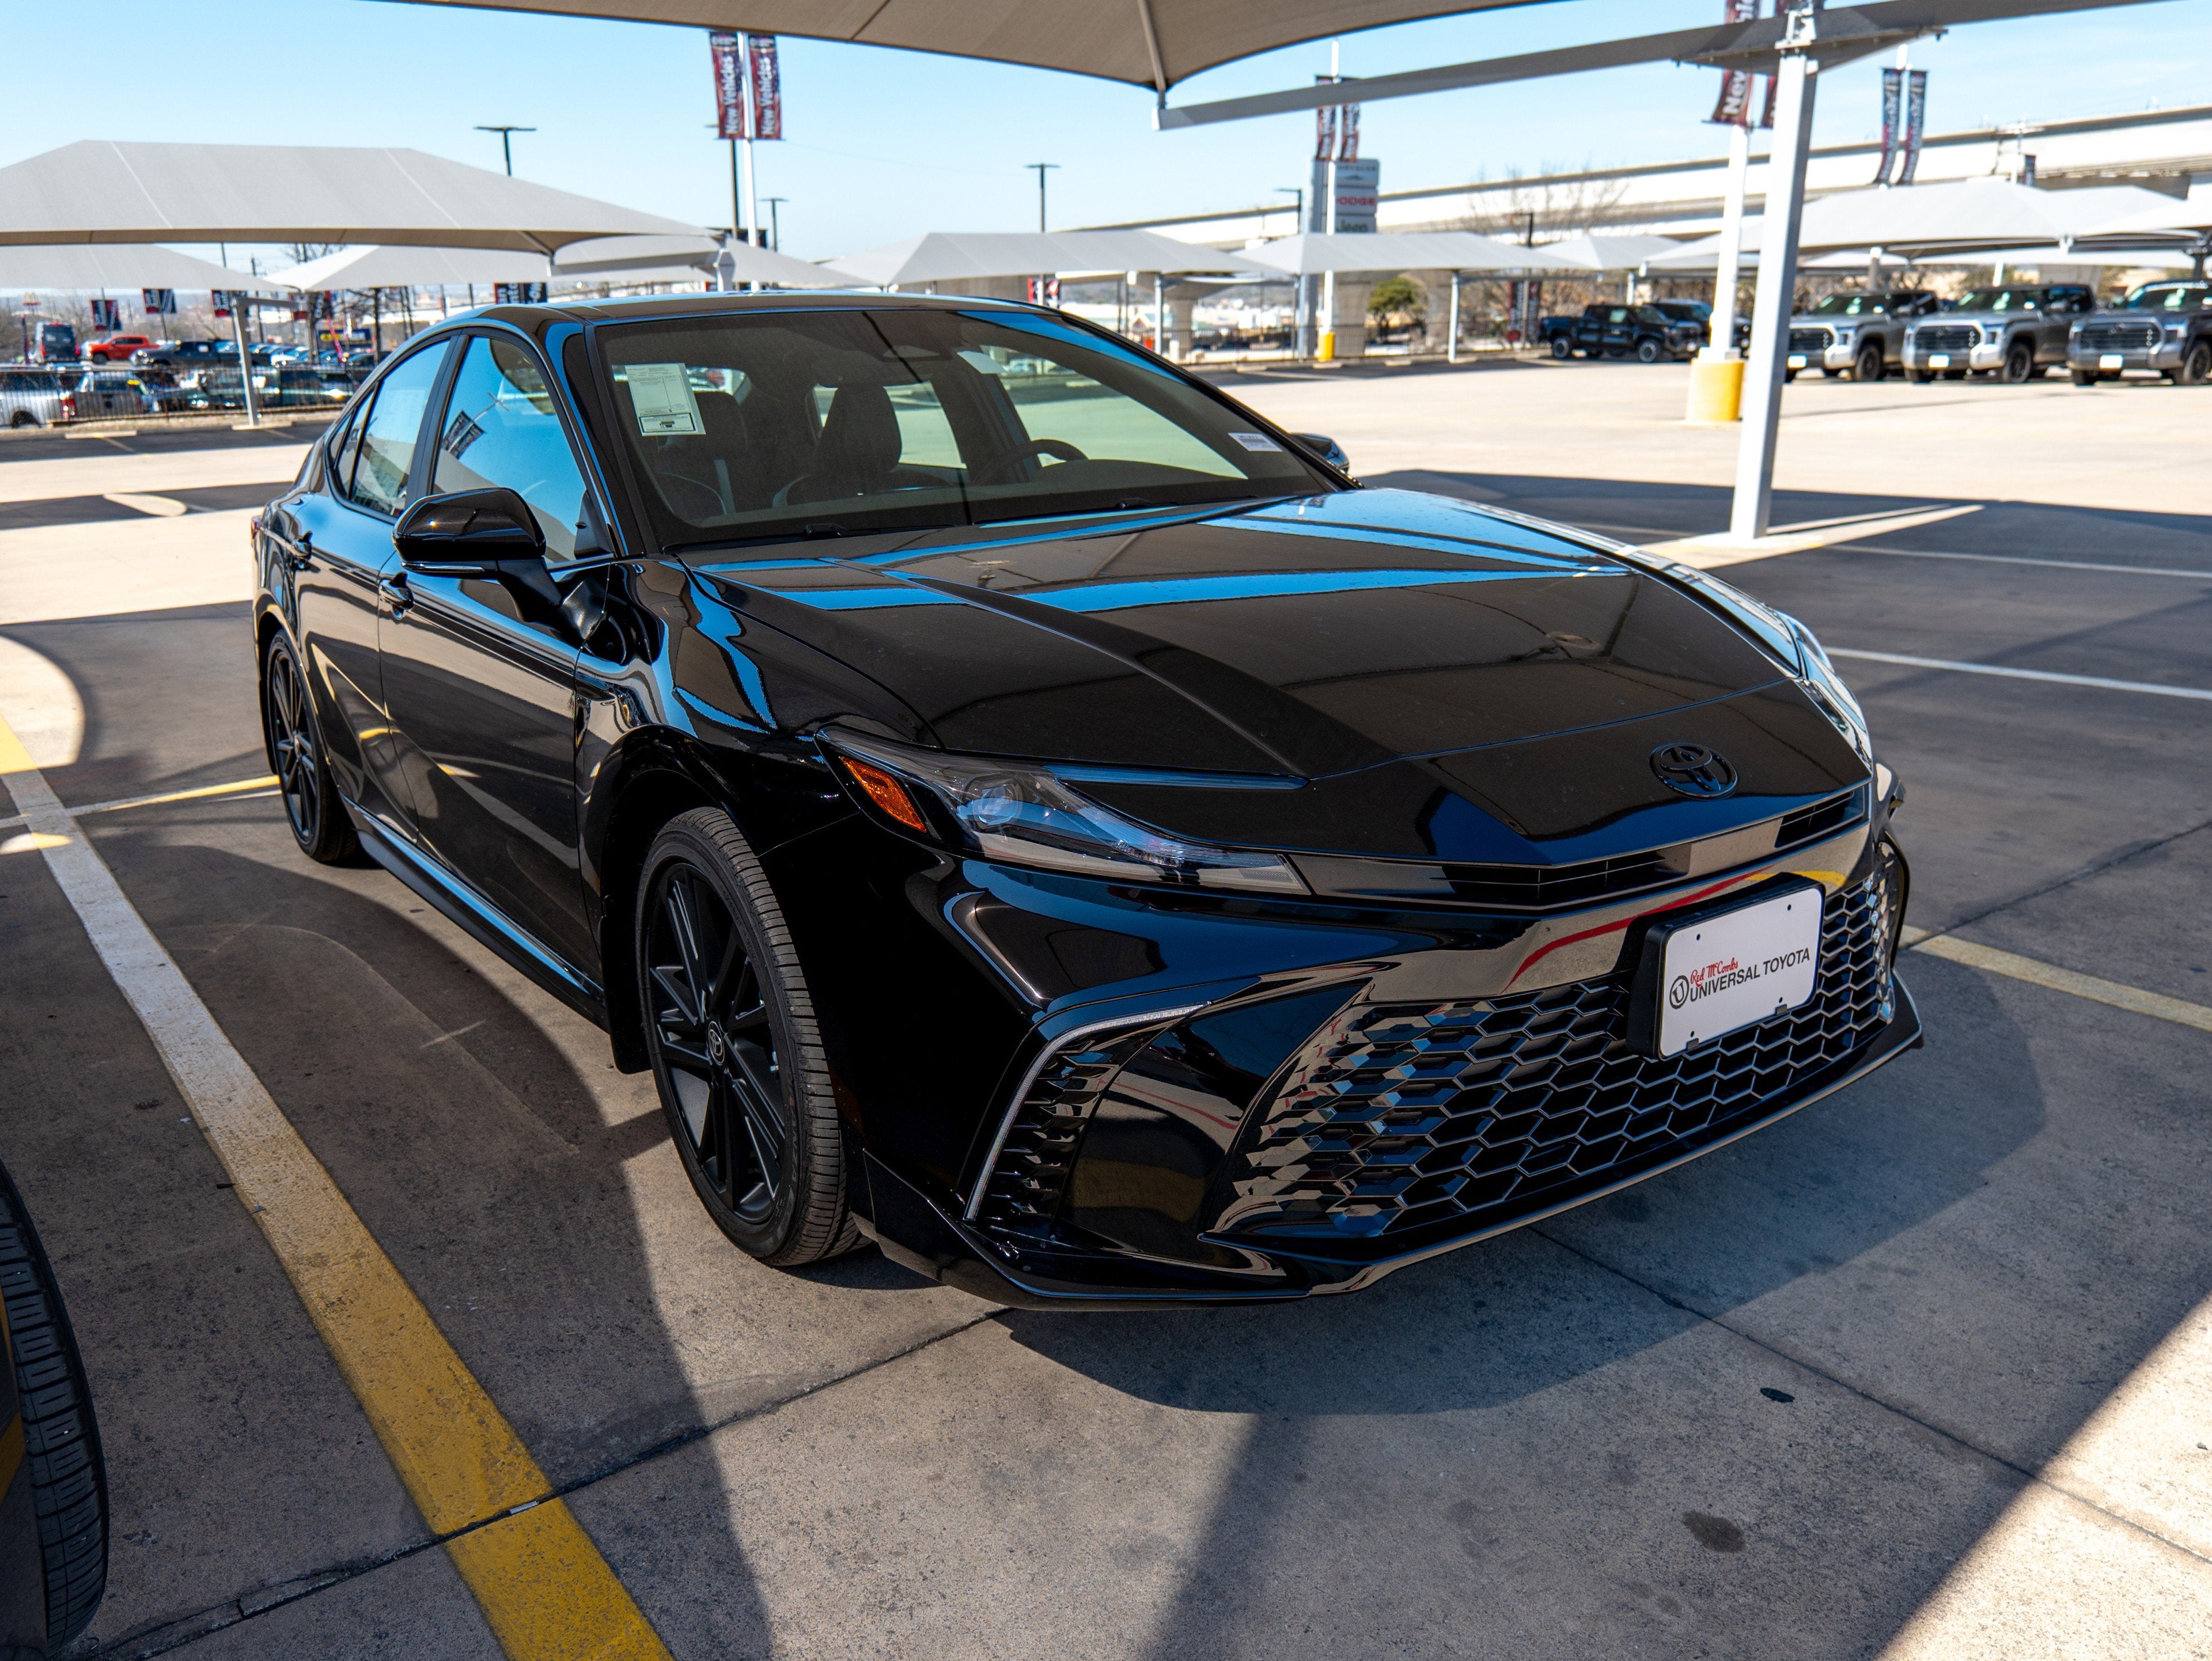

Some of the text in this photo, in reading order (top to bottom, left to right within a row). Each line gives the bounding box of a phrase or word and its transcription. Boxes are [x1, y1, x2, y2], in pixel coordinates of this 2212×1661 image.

[720, 55, 737, 105] Vehicles
[756, 56, 774, 107] Vehicles
[724, 108, 738, 134] New
[760, 108, 775, 134] New
[1690, 957, 1738, 987] Red McCombs
[1690, 948, 1810, 1002] UNIVERSAL TOYOTA
